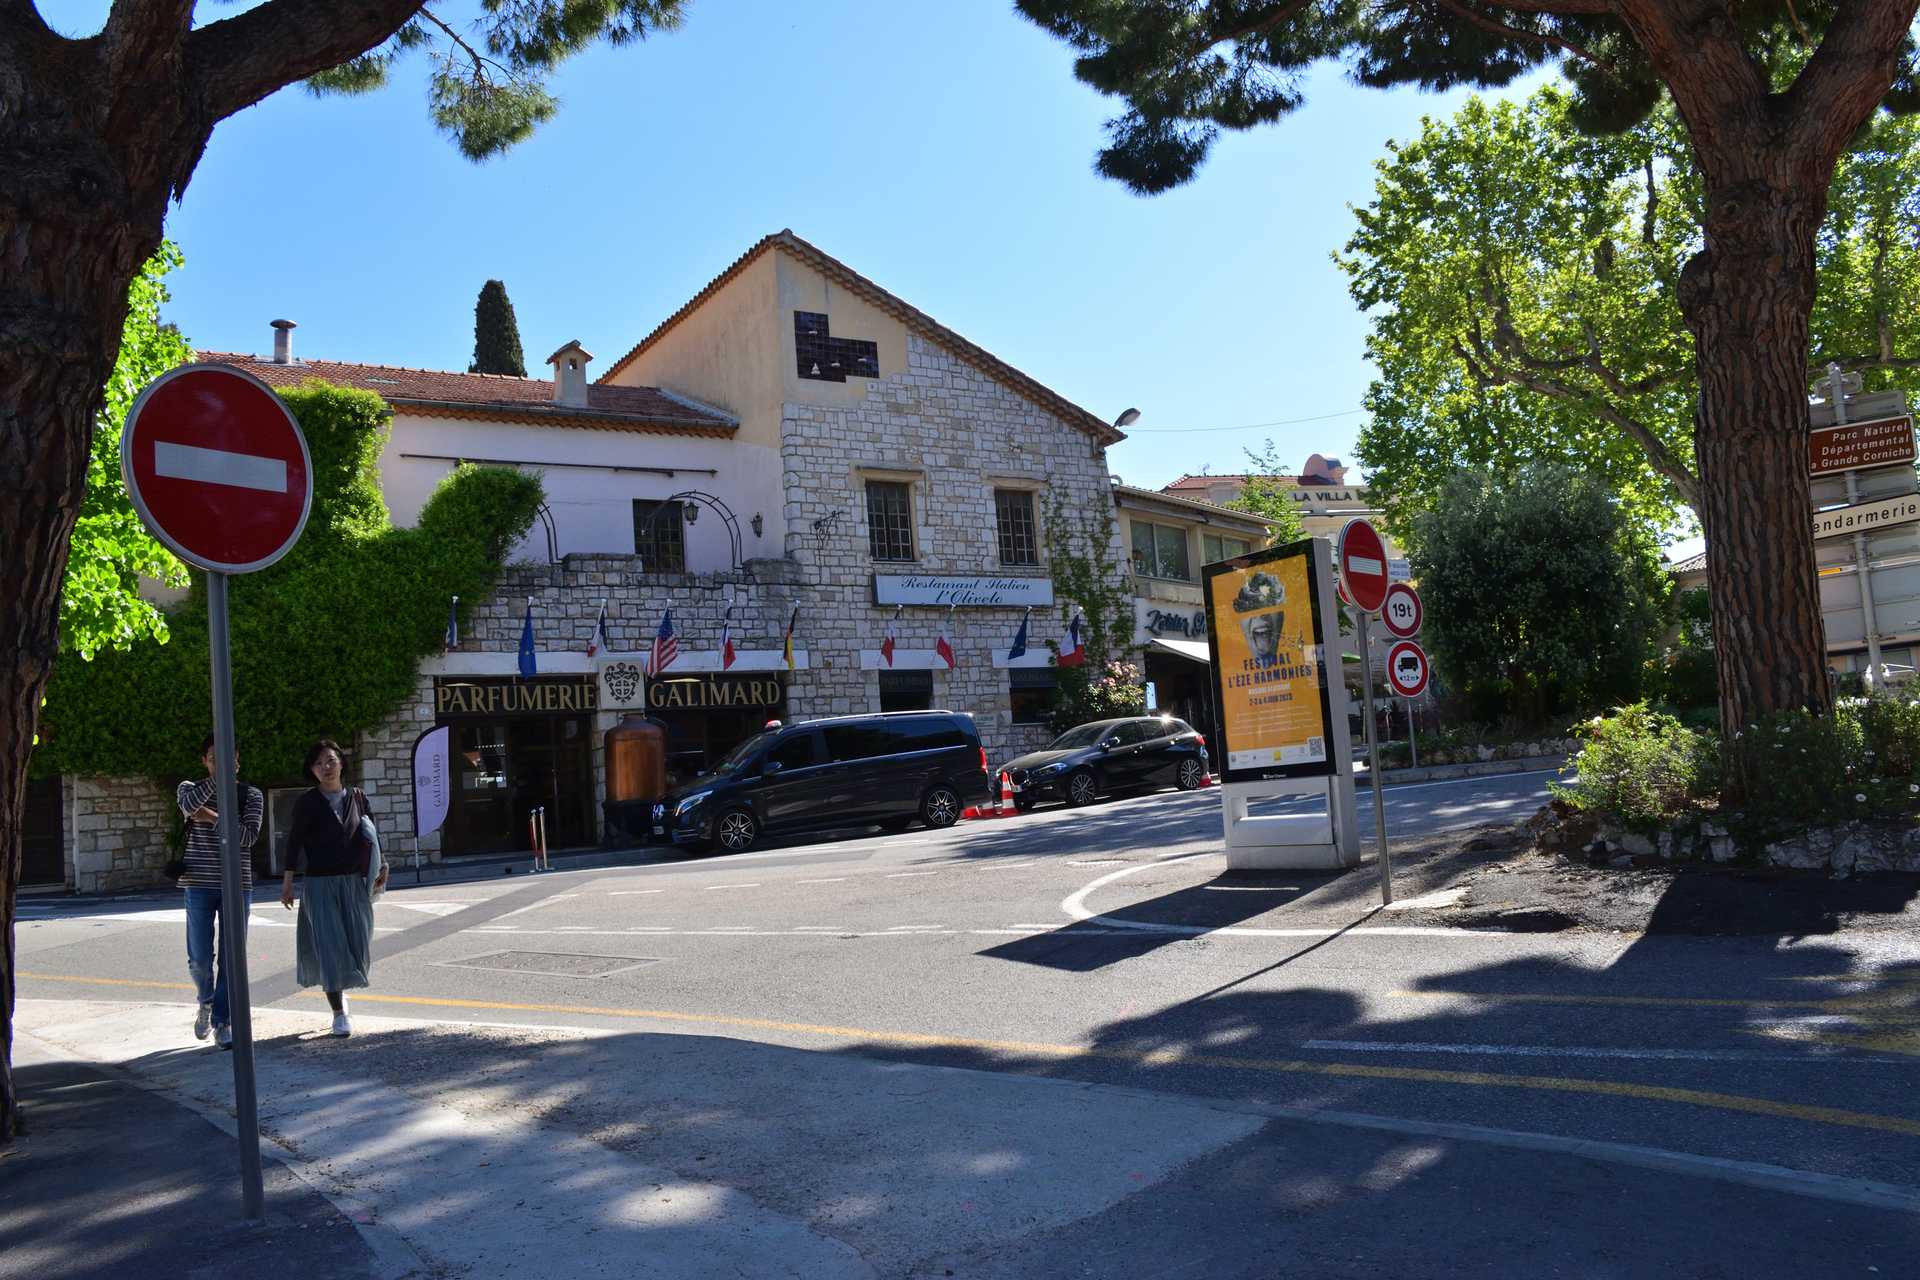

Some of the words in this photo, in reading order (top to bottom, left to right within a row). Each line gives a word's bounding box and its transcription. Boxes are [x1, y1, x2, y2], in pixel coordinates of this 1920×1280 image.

[1833, 432, 1857, 442] Parc
[1864, 422, 1908, 437] Naturel
[1822, 434, 1909, 456] Départemental
[1821, 454, 1859, 468] Grande
[1863, 447, 1911, 462] Corniche
[1294, 492, 1311, 502] LA
[1315, 491, 1352, 502] VILLA
[1813, 502, 1917, 534] endarmerie
[901, 575, 979, 590] Restaurant
[984, 577, 1032, 591] Italien
[1254, 664, 1312, 685] HARMONIES
[437, 684, 596, 713] PARFUMERIE
[649, 681, 781, 708] GALIMARD
[432, 753, 441, 808] GALIMARD
